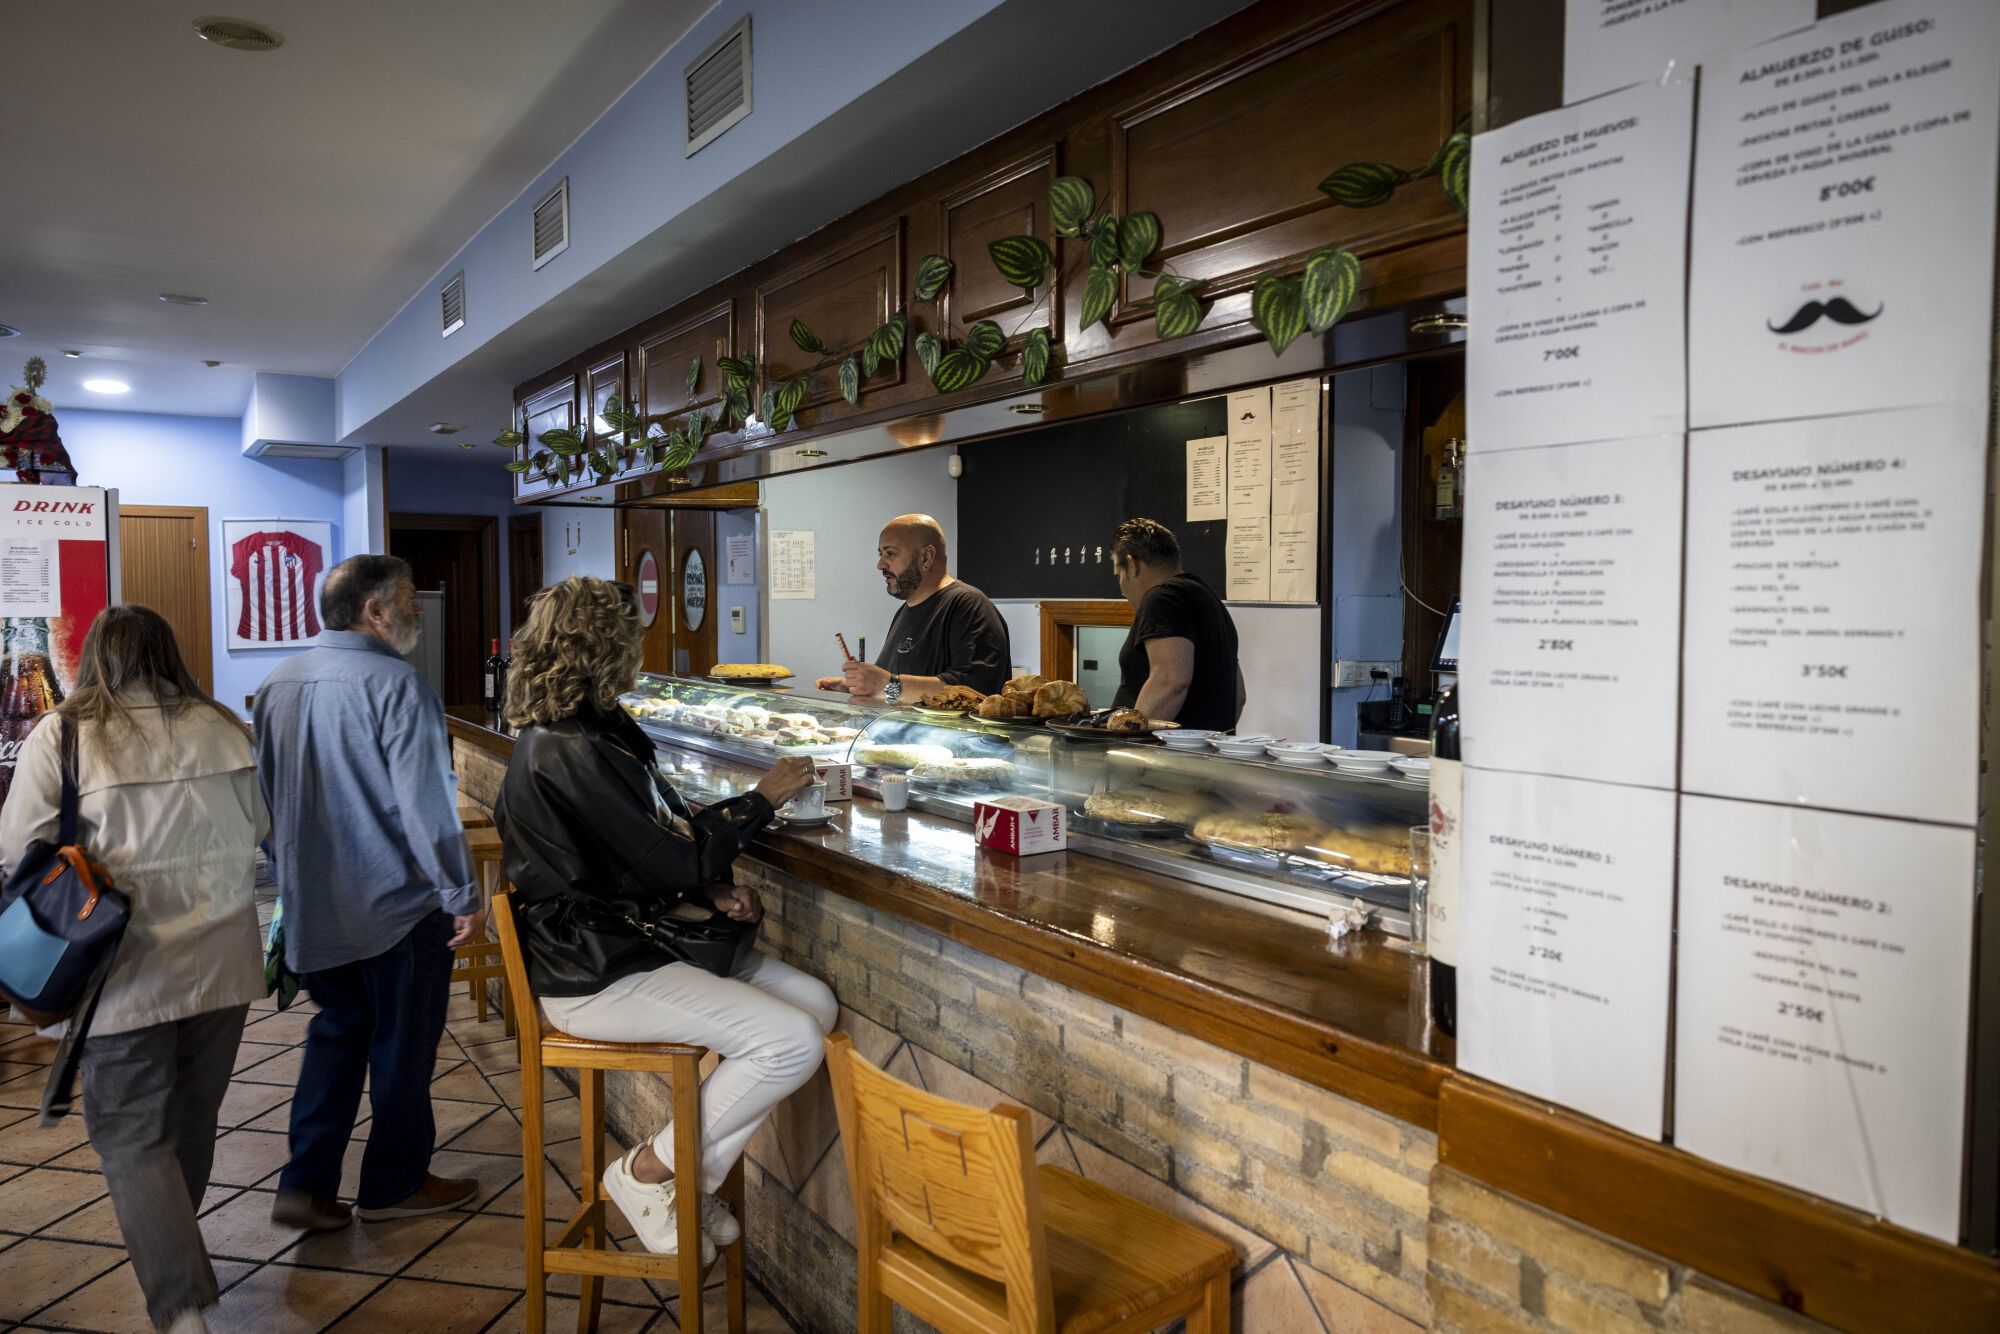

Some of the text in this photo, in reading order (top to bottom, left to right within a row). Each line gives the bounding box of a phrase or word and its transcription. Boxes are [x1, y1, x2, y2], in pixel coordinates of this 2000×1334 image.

[1740, 46, 1835, 82] ALMUERZO
[1839, 37, 1863, 54] DE
[1869, 18, 1934, 46] GUISO:
[1500, 138, 1560, 164] ALMUERZO
[1563, 132, 1578, 145] DE
[1583, 116, 1638, 139] HUEVOS:
[1544, 345, 1579, 360] 7'00€
[1732, 458, 1901, 481] DESAYUNO NÚMERO 4:
[13, 500, 96, 514] DRINK
[1495, 494, 1621, 511] DESAYUNO NÚMERO 3:
[1050, 547, 1057, 558] 2
[1095, 546, 1102, 556] 5
[1538, 639, 1573, 650] 2'80€
[1802, 664, 1847, 678] 3'50€
[1052, 807, 1060, 841] AMBAR
[1723, 875, 1801, 898] DESAYUNO
[1804, 890, 1873, 911] NÚMERO
[1877, 901, 1890, 914] 2:
[1528, 945, 1562, 962] 2'20€
[1778, 1002, 1824, 1023] 2'50€
